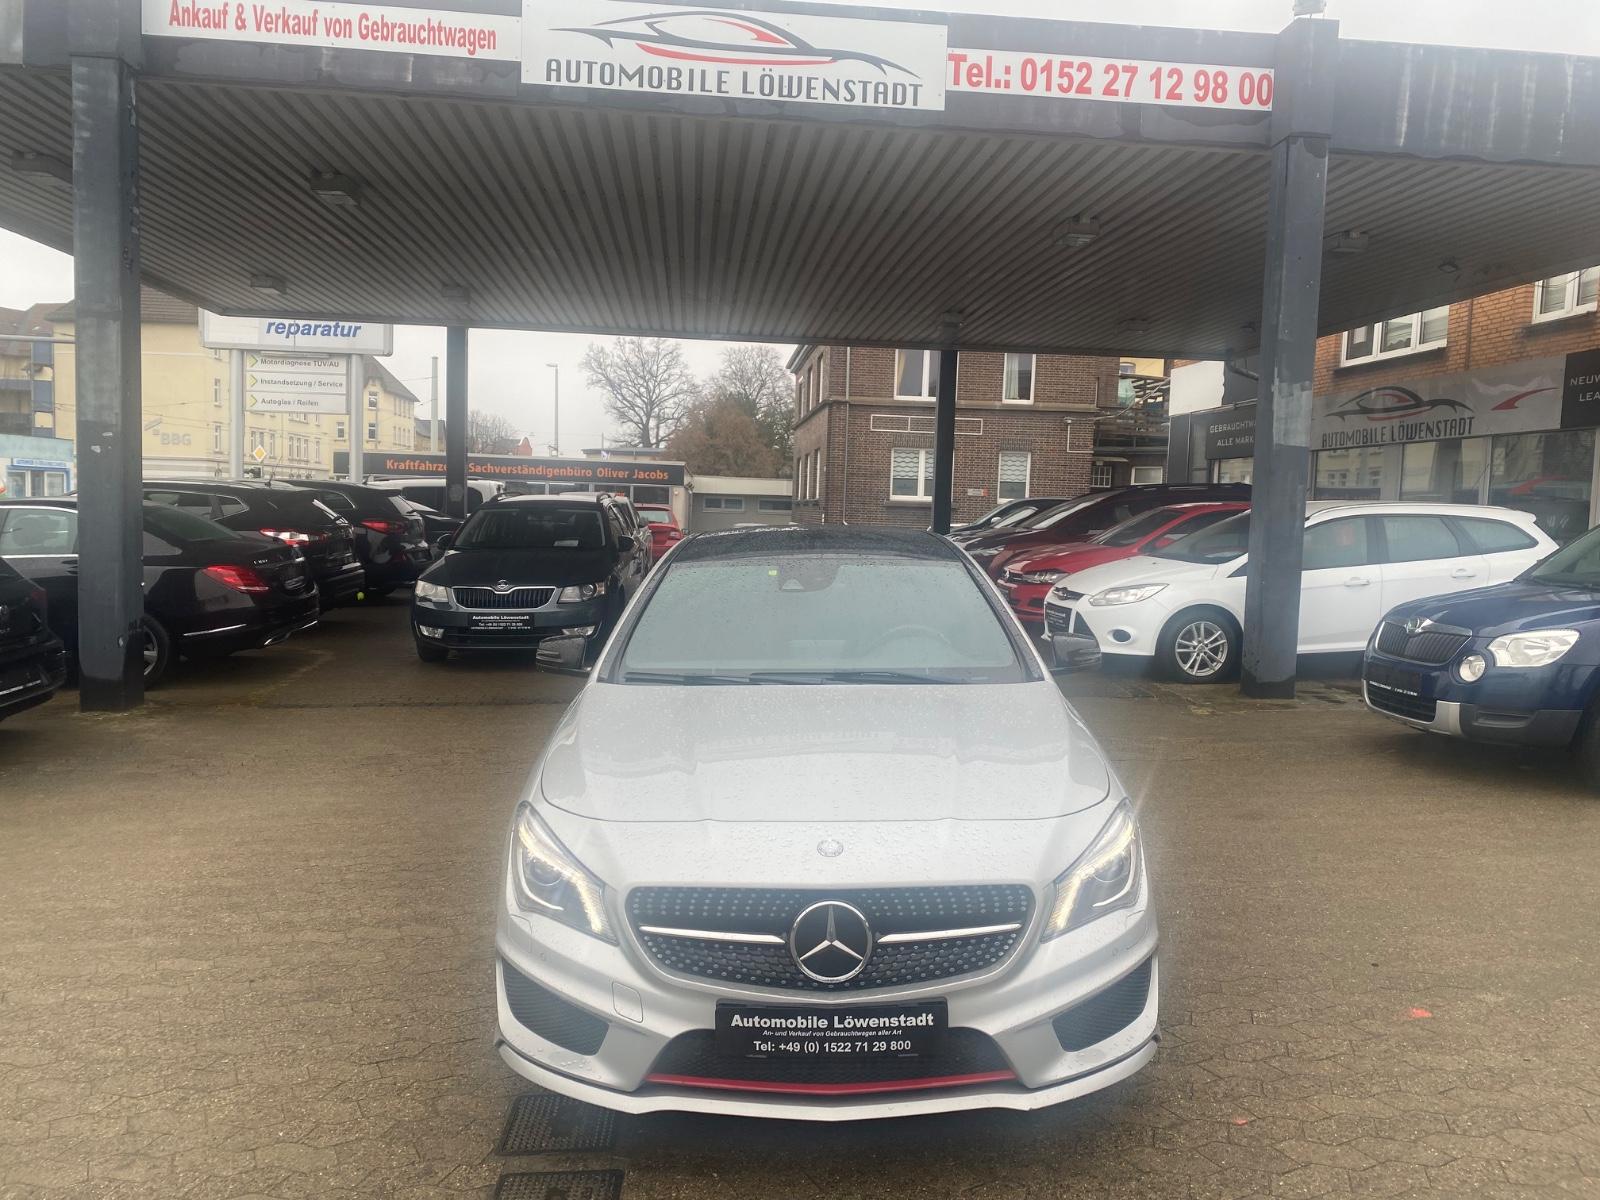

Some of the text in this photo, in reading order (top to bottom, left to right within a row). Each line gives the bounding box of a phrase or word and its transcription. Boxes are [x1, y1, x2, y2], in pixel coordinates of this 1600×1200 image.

[168, 0, 497, 56] Ankauf & Verkauf von Gebrauchtwagen
[545, 58, 923, 107] AUTOMOBILE LÖWENSTADT
[948, 53, 1273, 106] Tel.: 0152 27 12 98 00
[266, 320, 362, 338] reparatur
[260, 358, 311, 367] Motordiagnose
[260, 378, 313, 387] Instandsetzung
[317, 380, 343, 388] Service
[1322, 416, 1475, 448] AUTOMOBILE LÖWENSTADT
[1216, 437, 1233, 447] ALLE
[468, 462, 593, 478] Sachverständigenbüro
[596, 468, 629, 480] Oliver
[632, 469, 669, 481] Jacobs
[731, 1013, 934, 1029] Automobile Löwenstadt
[825, 1030, 877, 1038] Gebrauchtwagen
[753, 1040, 911, 1053] Tel: +49 (0) 1522 71 29 800
